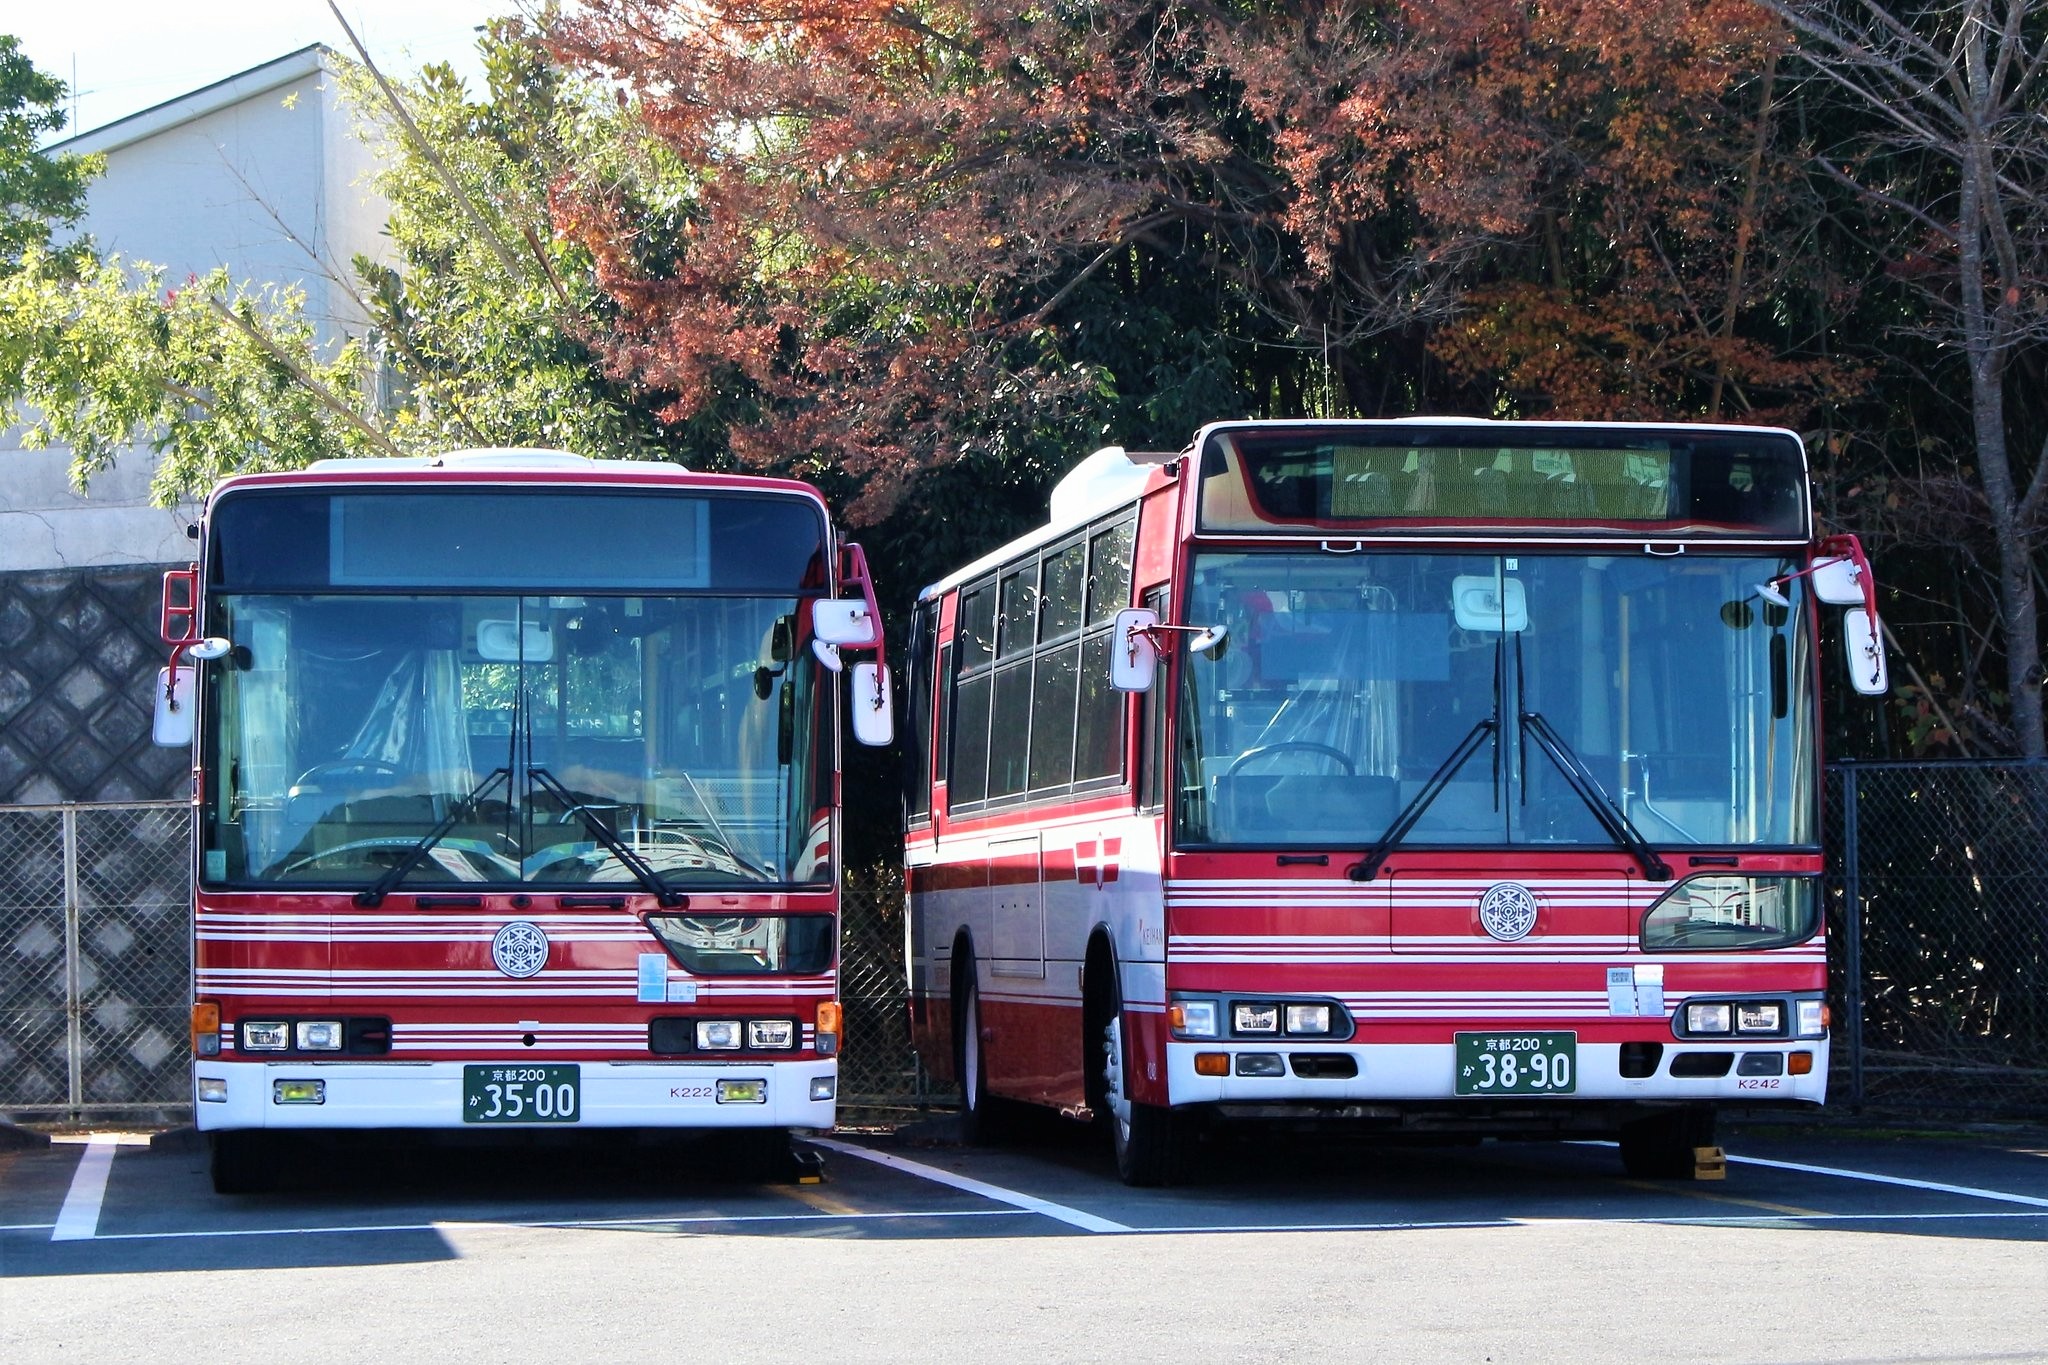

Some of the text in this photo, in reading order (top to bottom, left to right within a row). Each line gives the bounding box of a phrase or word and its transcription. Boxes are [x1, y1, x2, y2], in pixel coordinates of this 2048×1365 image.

[1478, 1053, 1570, 1088] 38-90
[670, 1087, 712, 1098] K222
[1738, 1079, 1780, 1089] K242
[484, 1083, 575, 1118] 35-00
